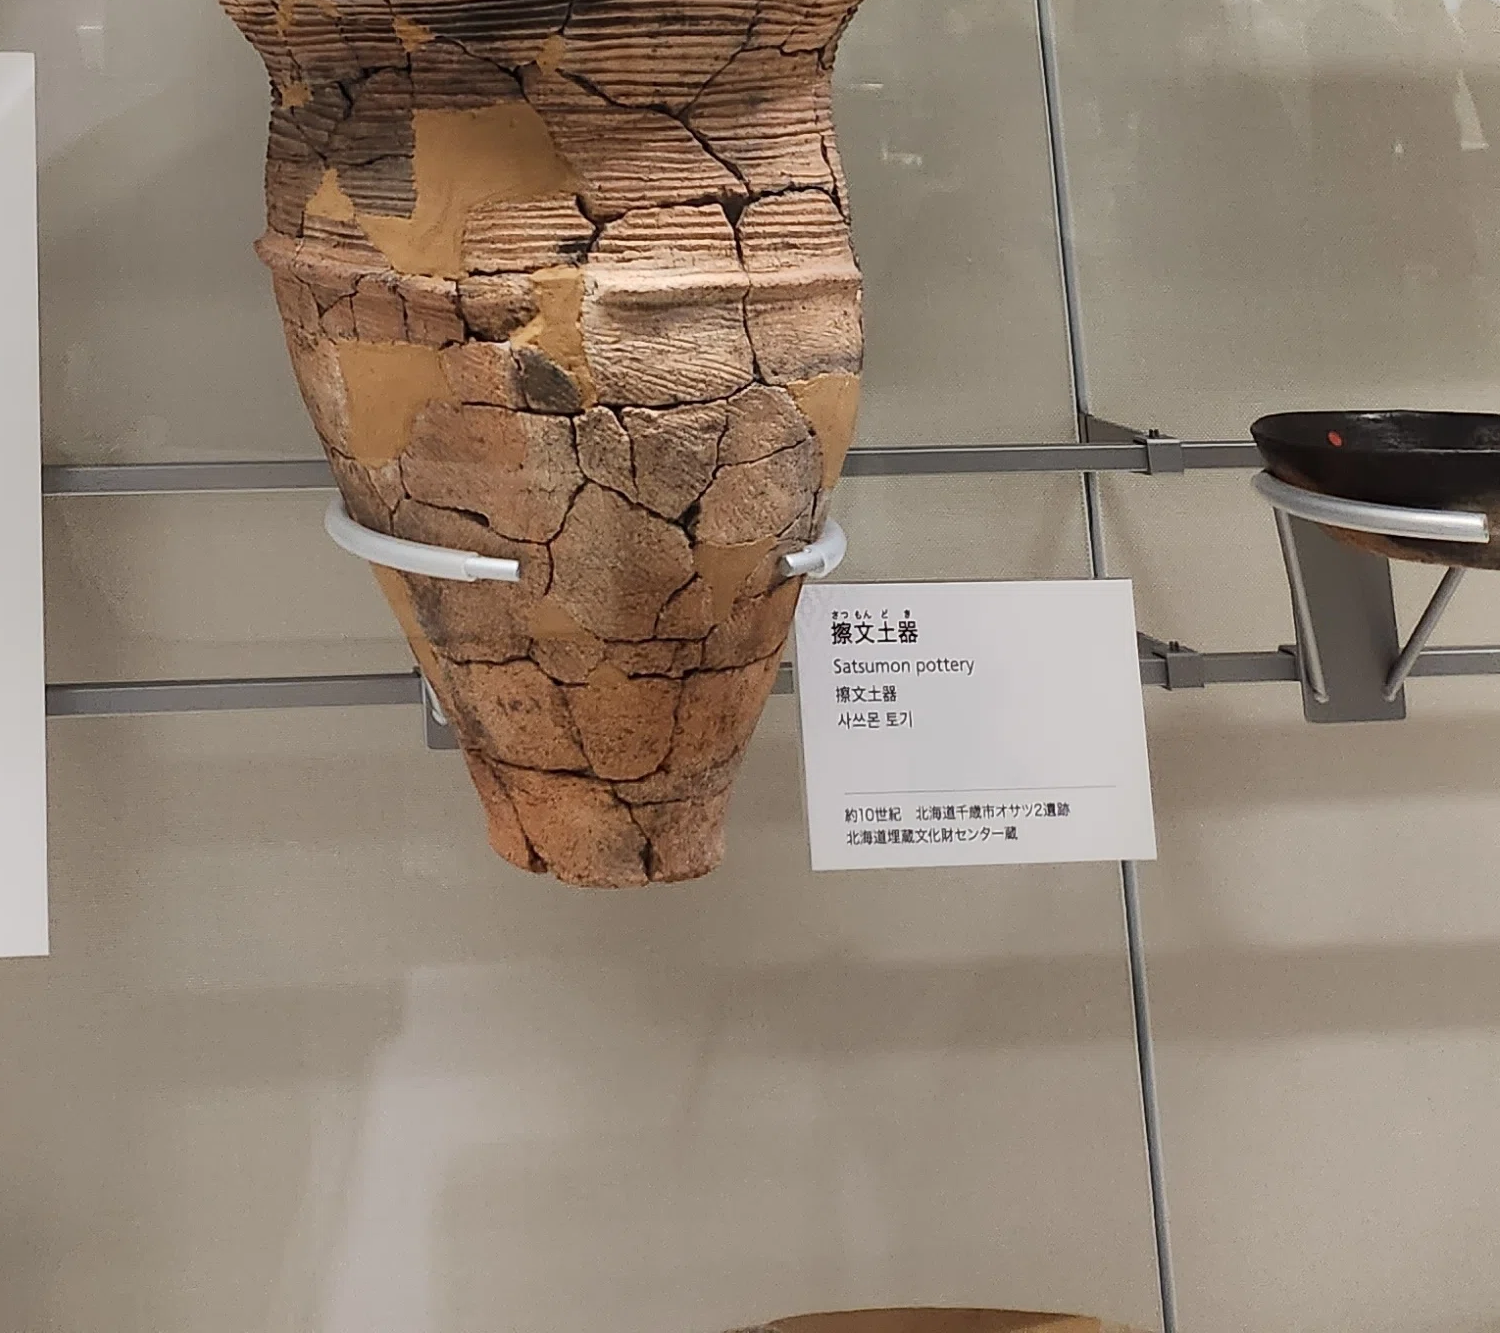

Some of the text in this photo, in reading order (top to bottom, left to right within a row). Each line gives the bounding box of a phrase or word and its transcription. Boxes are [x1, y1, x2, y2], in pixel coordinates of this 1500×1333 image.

[831, 620, 918, 645] 擦文土器
[833, 658, 975, 676] Satsumon pottery
[835, 685, 897, 703] 擦文土器
[838, 710, 914, 729] 사쓰몬 토기
[844, 807, 902, 822] 約10世紀
